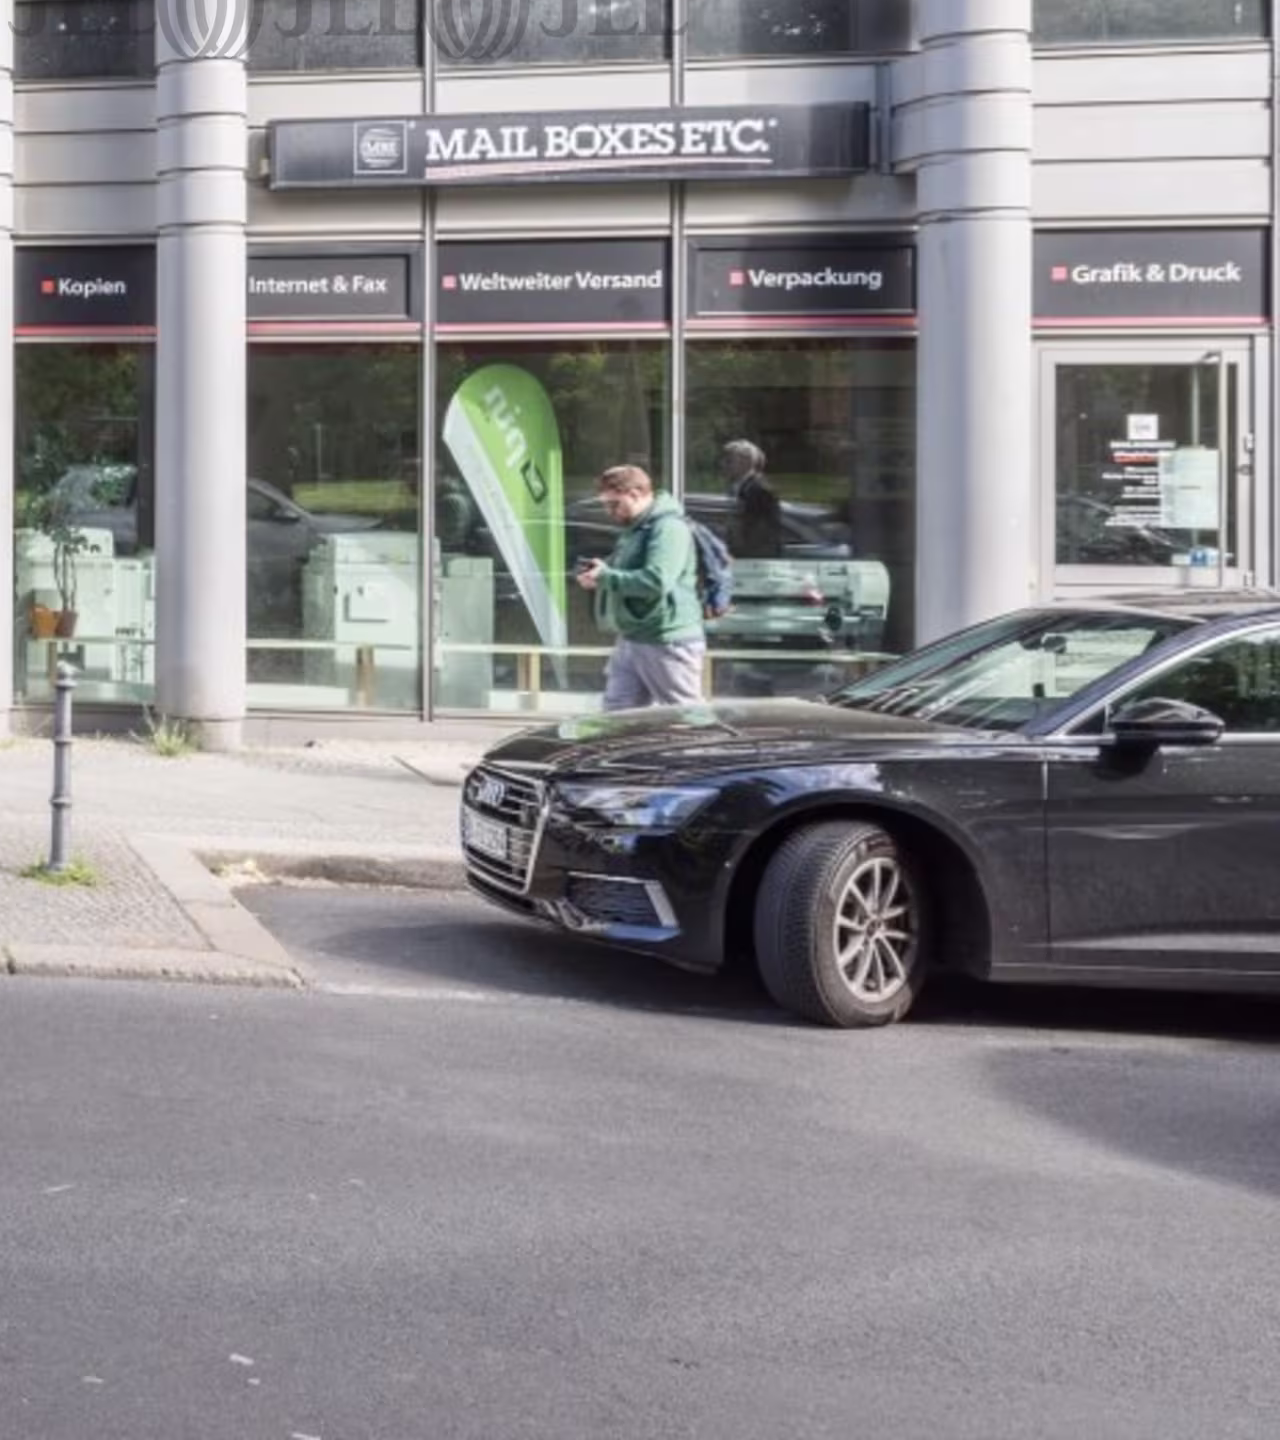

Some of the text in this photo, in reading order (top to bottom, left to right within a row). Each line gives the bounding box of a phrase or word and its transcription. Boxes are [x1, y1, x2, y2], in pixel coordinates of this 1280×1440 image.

[425, 125, 537, 161] MAIL
[544, 121, 675, 157] BOXES
[460, 270, 663, 291] Weltweiter Versand
[747, 267, 883, 290] Verpackung
[1071, 261, 1241, 284] Grafik & Druck
[58, 277, 127, 299] Kopien
[249, 274, 388, 294] Internet & Fax
